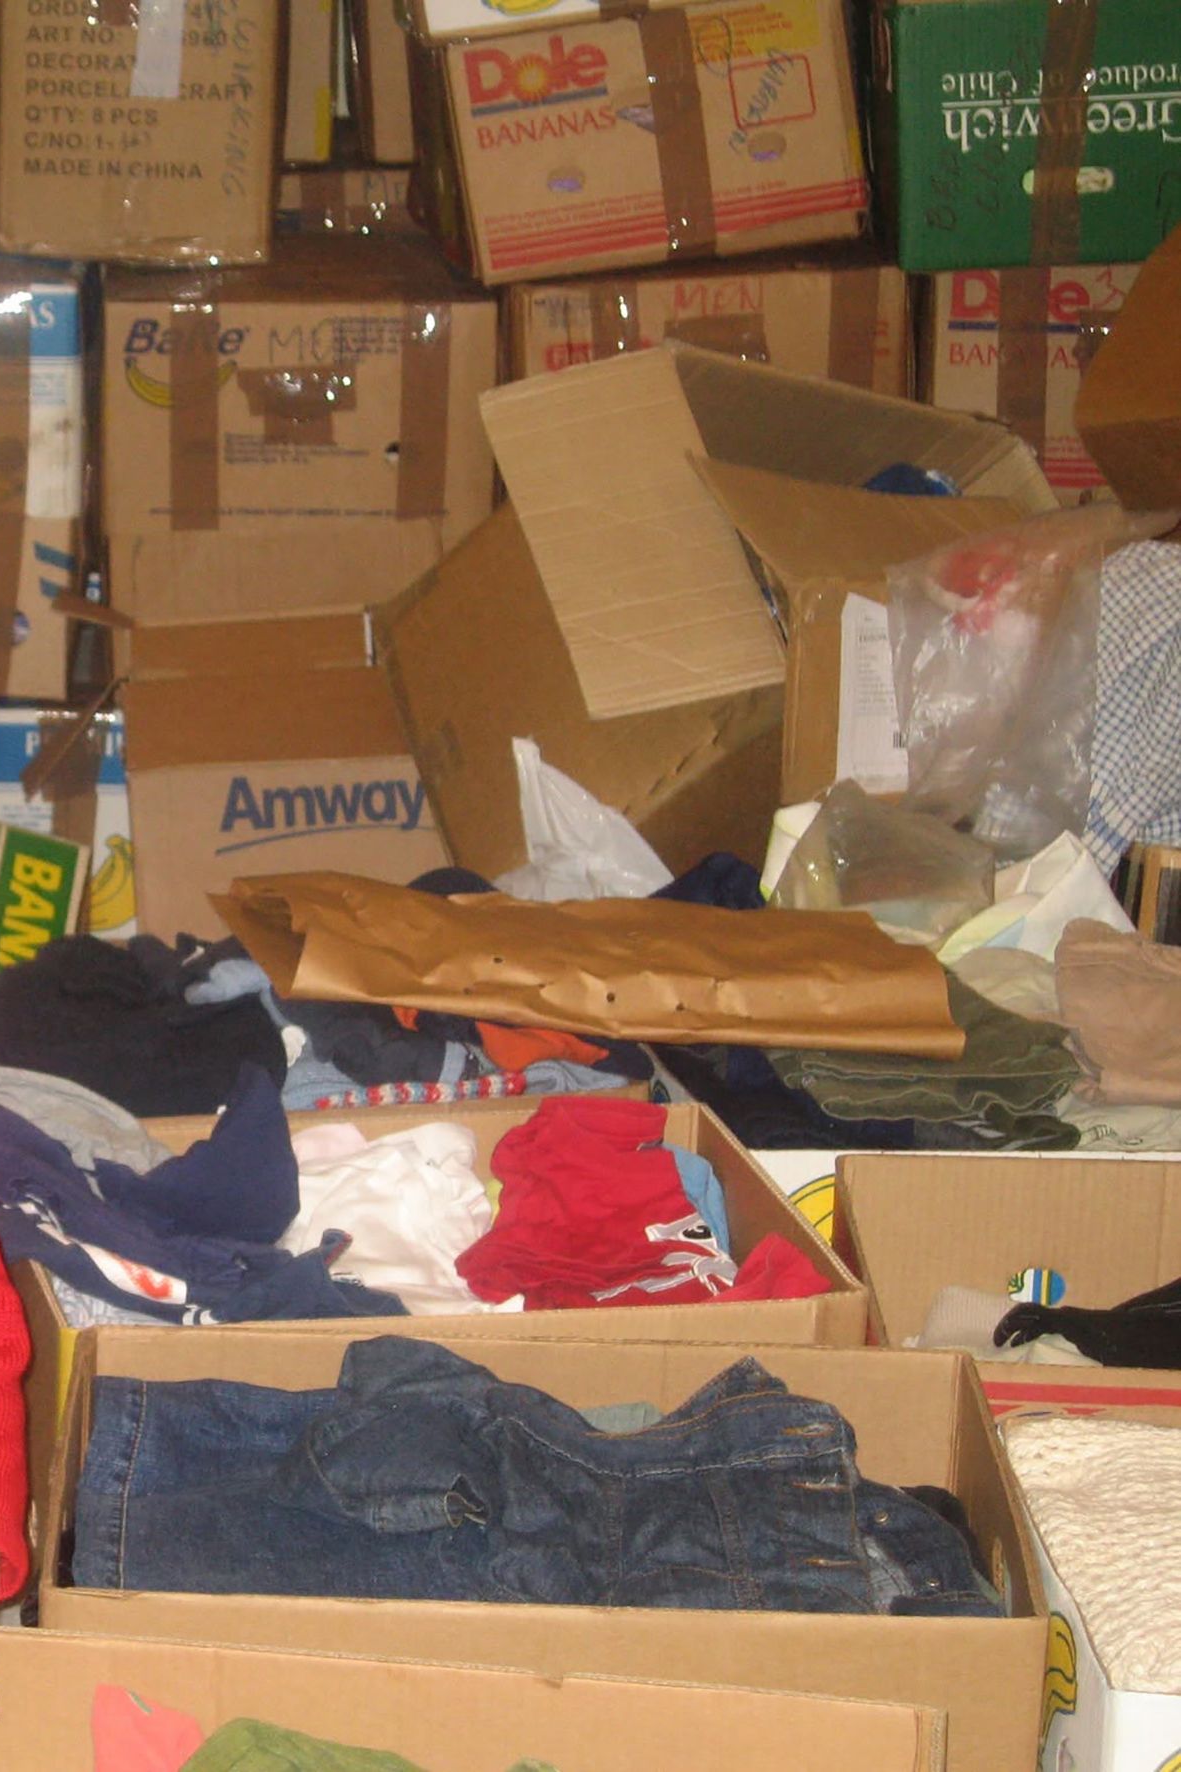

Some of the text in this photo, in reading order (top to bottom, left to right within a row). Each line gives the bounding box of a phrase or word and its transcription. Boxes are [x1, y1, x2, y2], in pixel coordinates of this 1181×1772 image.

[464, 34, 609, 105] Dole
[941, 70, 1017, 99] Chile
[111, 108, 159, 125] PCS
[477, 104, 617, 149] BANANAS
[23, 157, 203, 179] MADE IN CHINA
[221, 776, 427, 832] Amway
